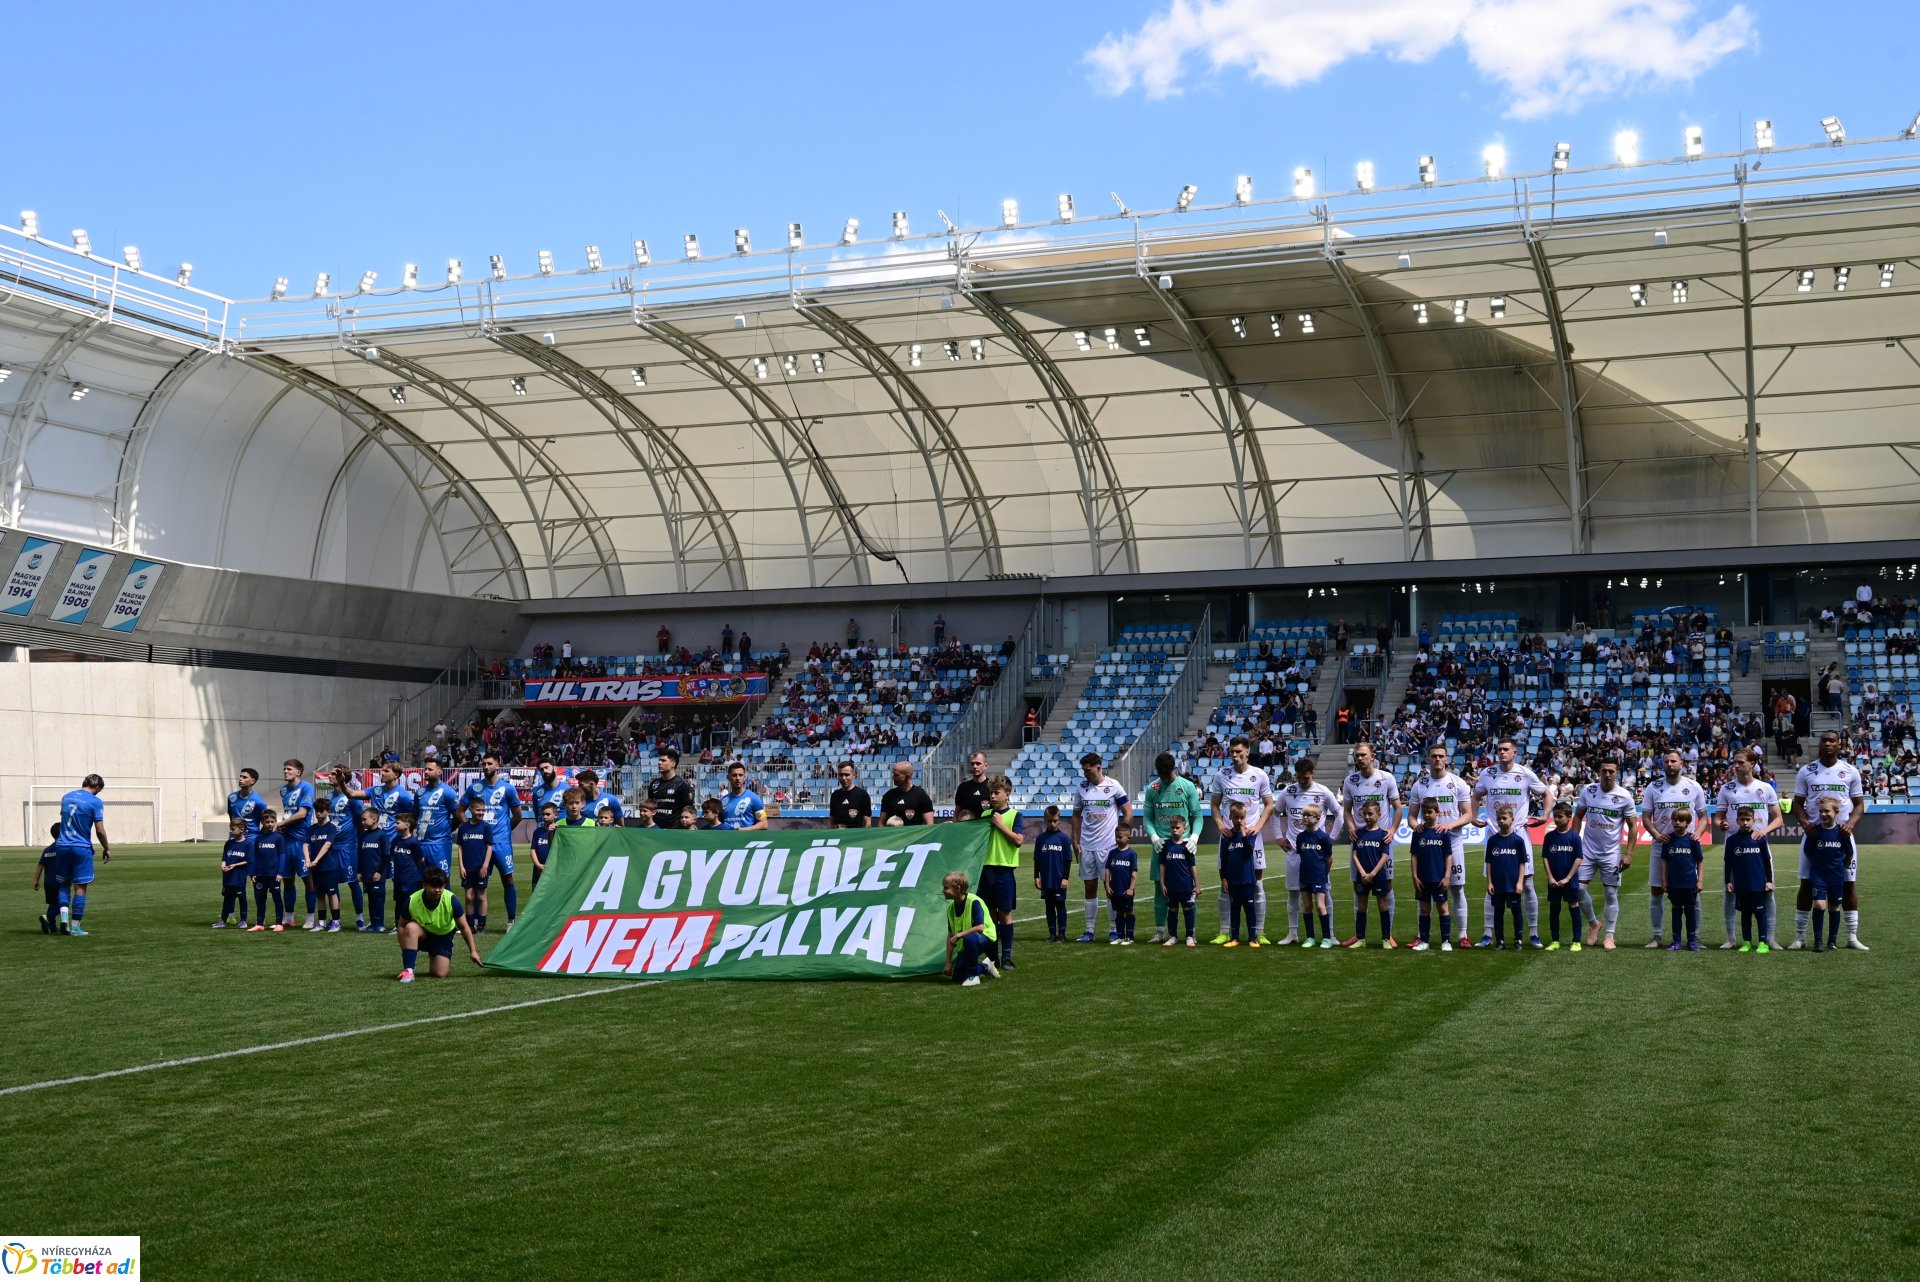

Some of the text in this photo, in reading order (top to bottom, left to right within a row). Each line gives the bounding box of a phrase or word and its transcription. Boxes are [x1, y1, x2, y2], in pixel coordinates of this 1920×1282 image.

[14, 572, 41, 582] MAGYAR
[11, 578, 38, 588] BAJNOK
[70, 582, 96, 591] MAGYAR
[8, 586, 32, 598] 1914
[67, 588, 93, 597] BAJNOK
[122, 592, 146, 600] MAGYAR
[62, 596, 89, 608] 1908
[119, 598, 143, 606] BAJNOK
[114, 604, 140, 616] 1904
[535, 680, 663, 702] ULTRAS
[68, 804, 78, 827] 7
[1255, 850, 1262, 858] 15
[579, 838, 942, 911] A GYŰLÖLET
[1452, 865, 1462, 874] 98
[540, 915, 714, 974] NEM
